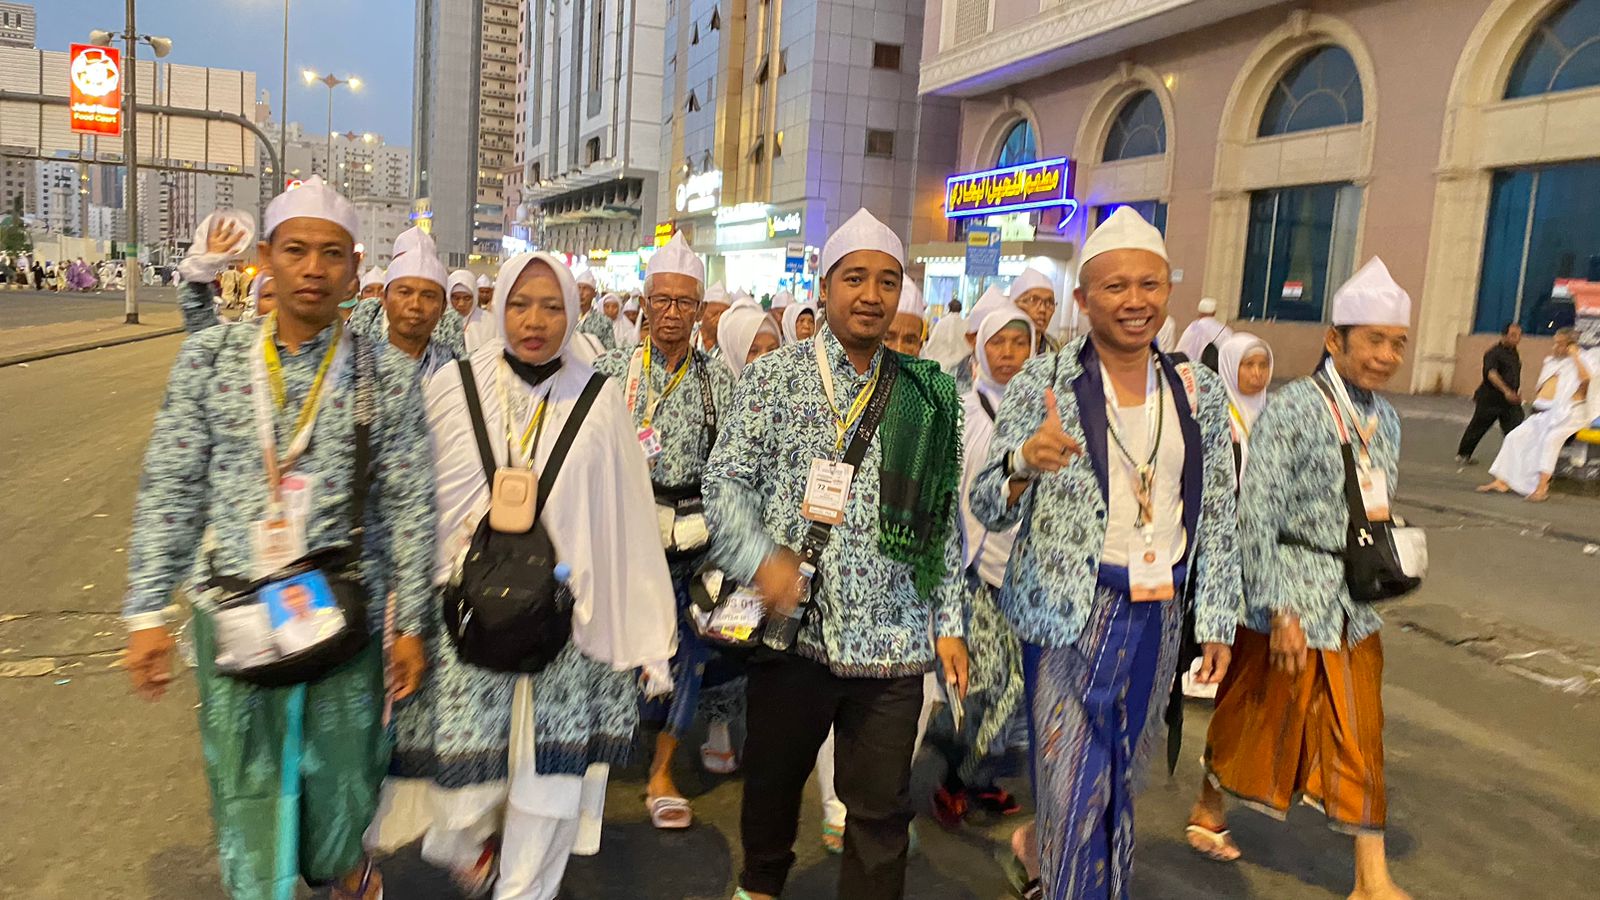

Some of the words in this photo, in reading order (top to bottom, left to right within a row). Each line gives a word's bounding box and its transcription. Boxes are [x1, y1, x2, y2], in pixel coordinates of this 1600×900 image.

[74, 111, 95, 121] Food
[95, 114, 117, 123] Court
[1024, 167, 1059, 199] مطعم
